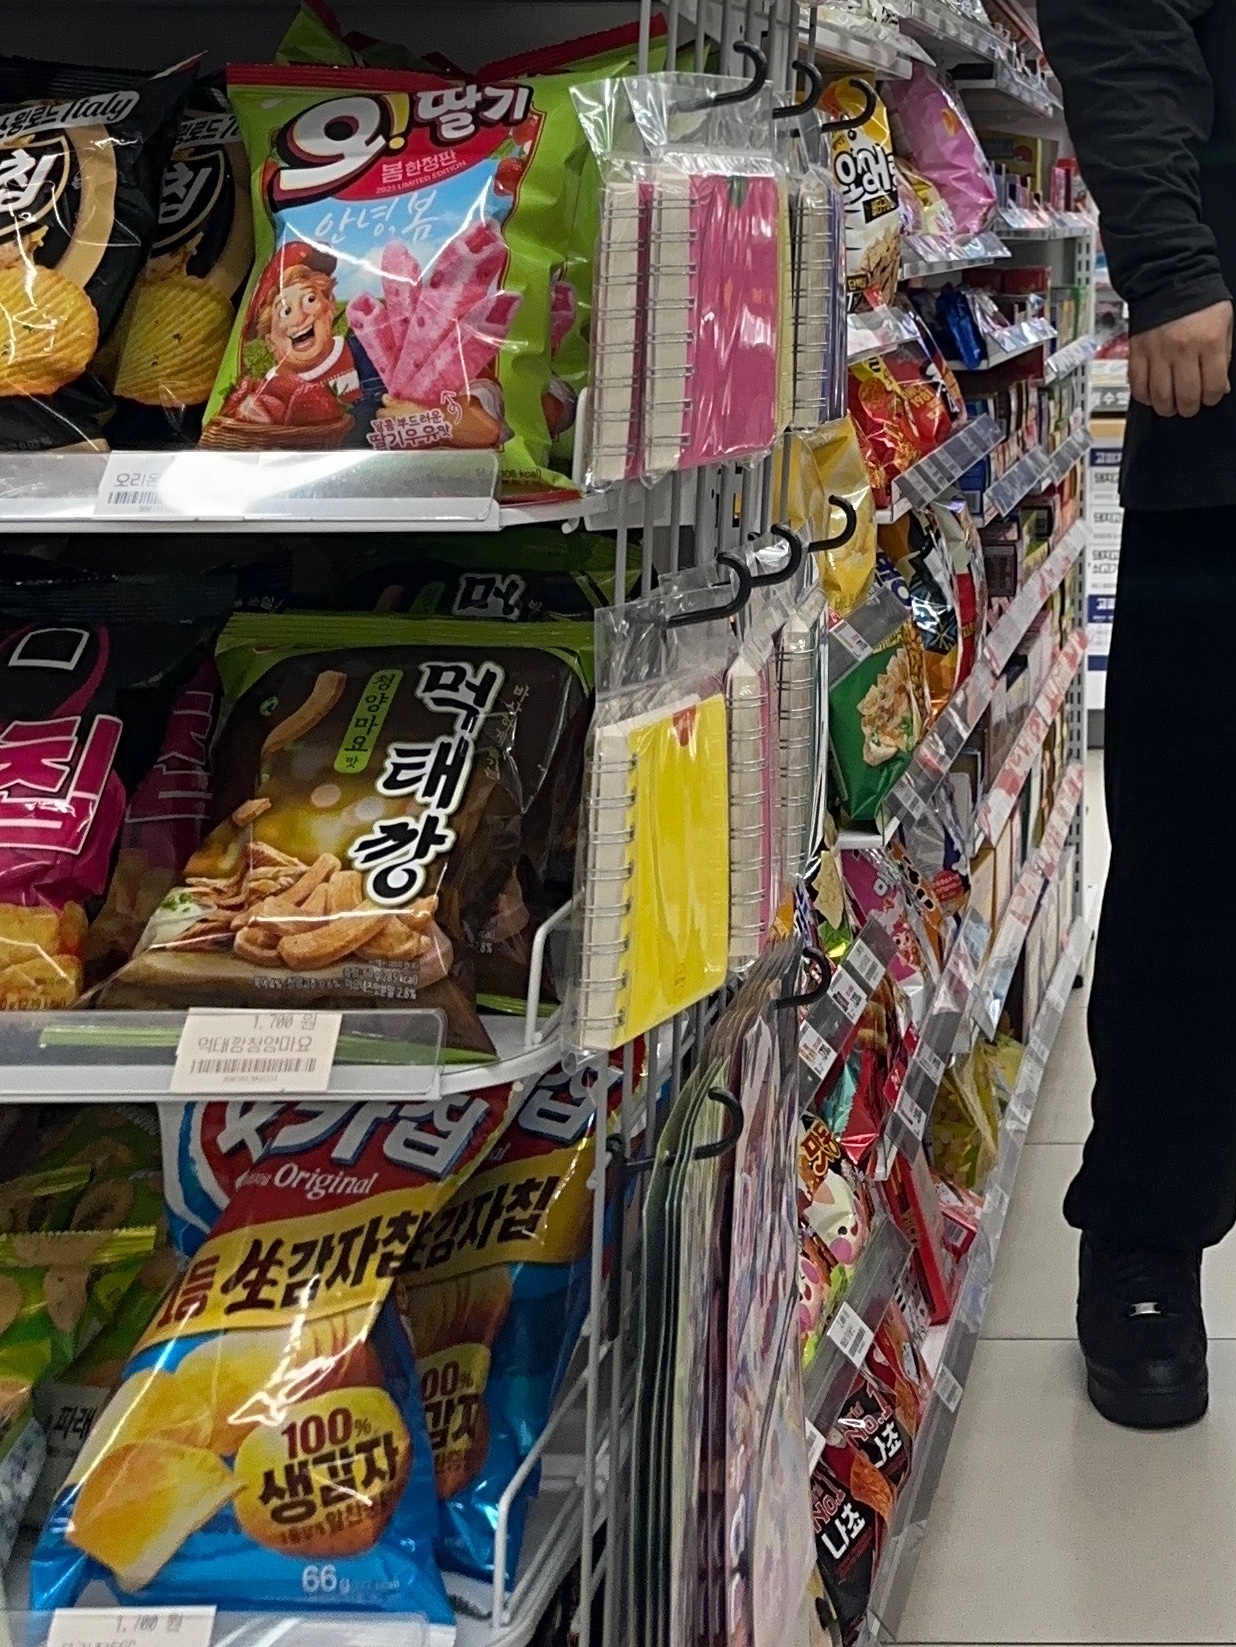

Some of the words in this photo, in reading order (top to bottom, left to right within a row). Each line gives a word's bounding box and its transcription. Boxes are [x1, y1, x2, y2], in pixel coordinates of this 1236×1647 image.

[61, 93, 131, 122] Italy
[381, 162, 404, 185] 봄
[405, 149, 457, 178] 한정판
[398, 173, 431, 191] LIMITED
[432, 159, 467, 179] EDITION
[396, 410, 443, 430] 부드러운
[352, 661, 503, 905] 먹태깡
[273, 1162, 381, 1201] Original
[420, 1359, 475, 1401] 00%
[280, 1406, 373, 1460] 100%
[258, 1429, 401, 1526] 생감자
[301, 1564, 338, 1593] 66
